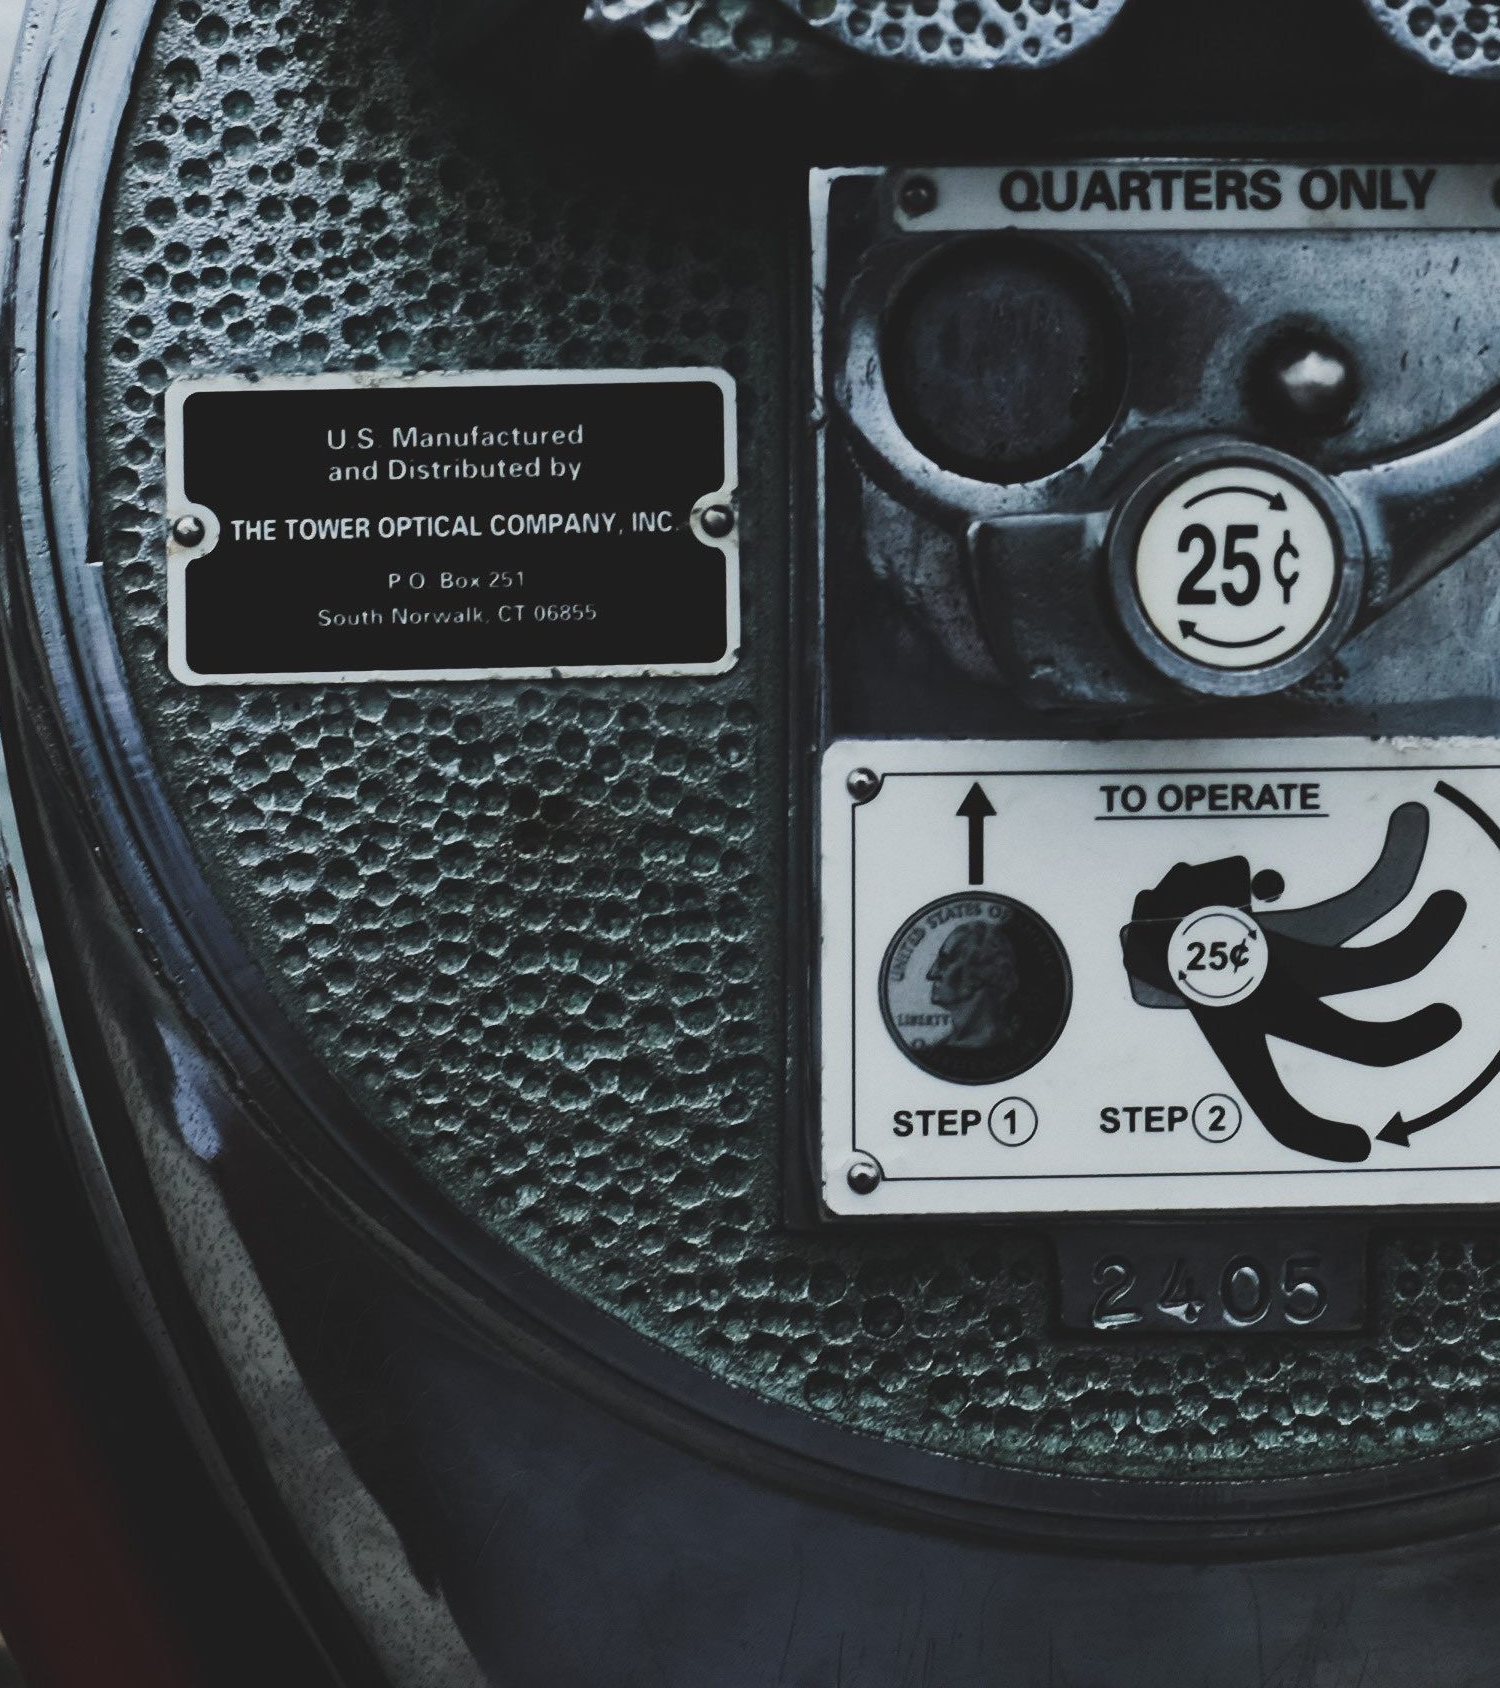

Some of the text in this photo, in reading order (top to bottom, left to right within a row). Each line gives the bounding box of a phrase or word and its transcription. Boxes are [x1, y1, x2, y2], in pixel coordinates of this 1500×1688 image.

[999, 168, 1438, 212] QUARTERS ONLY
[392, 424, 584, 448] Manufactured
[328, 456, 582, 482] and Distributed by
[230, 510, 680, 542] THE TOWER OPTICAL COMPANY, INC.
[1176, 522, 1300, 607] 25¢
[439, 572, 481, 589] Box
[488, 571, 524, 588] 251
[318, 609, 384, 627] South
[498, 604, 526, 623] CT
[533, 604, 598, 623] 06855
[1099, 782, 1322, 813] TO OPERATE
[1186, 938, 1250, 974] 25¢
[892, 1108, 982, 1138] STEP
[1099, 1104, 1189, 1134] STEP
[1091, 1251, 1329, 1331] 2405
